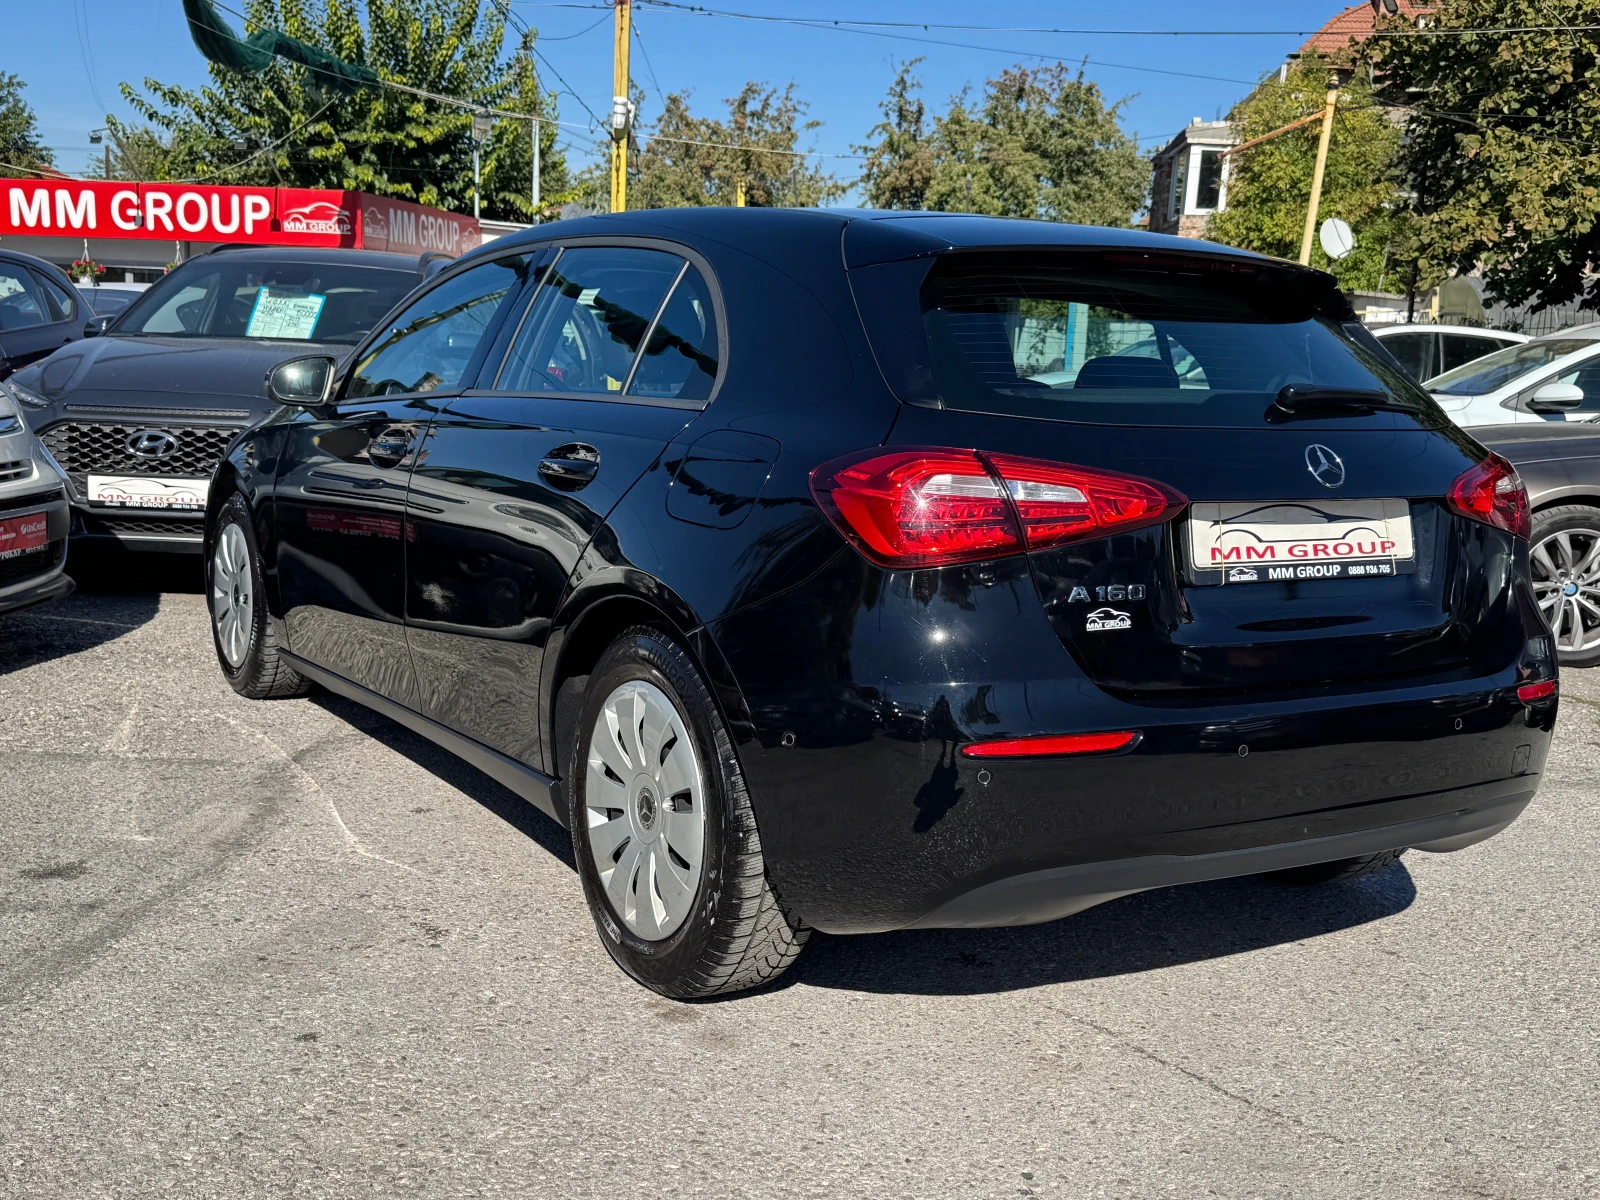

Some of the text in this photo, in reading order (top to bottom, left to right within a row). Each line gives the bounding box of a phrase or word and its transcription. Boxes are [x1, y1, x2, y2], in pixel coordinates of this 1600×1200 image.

[9, 187, 271, 235] MM GROUP
[284, 221, 351, 232] MM GROUP
[389, 207, 460, 252] MM GROUP
[97, 493, 206, 504] MM GROUP
[26, 521, 47, 533] UniCredit
[1210, 540, 1396, 561] MM GROUP
[1268, 564, 1391, 580] MM GROUP 0888 936 705
[1067, 584, 1146, 603] A 160
[1086, 620, 1132, 630] MM GROUP
